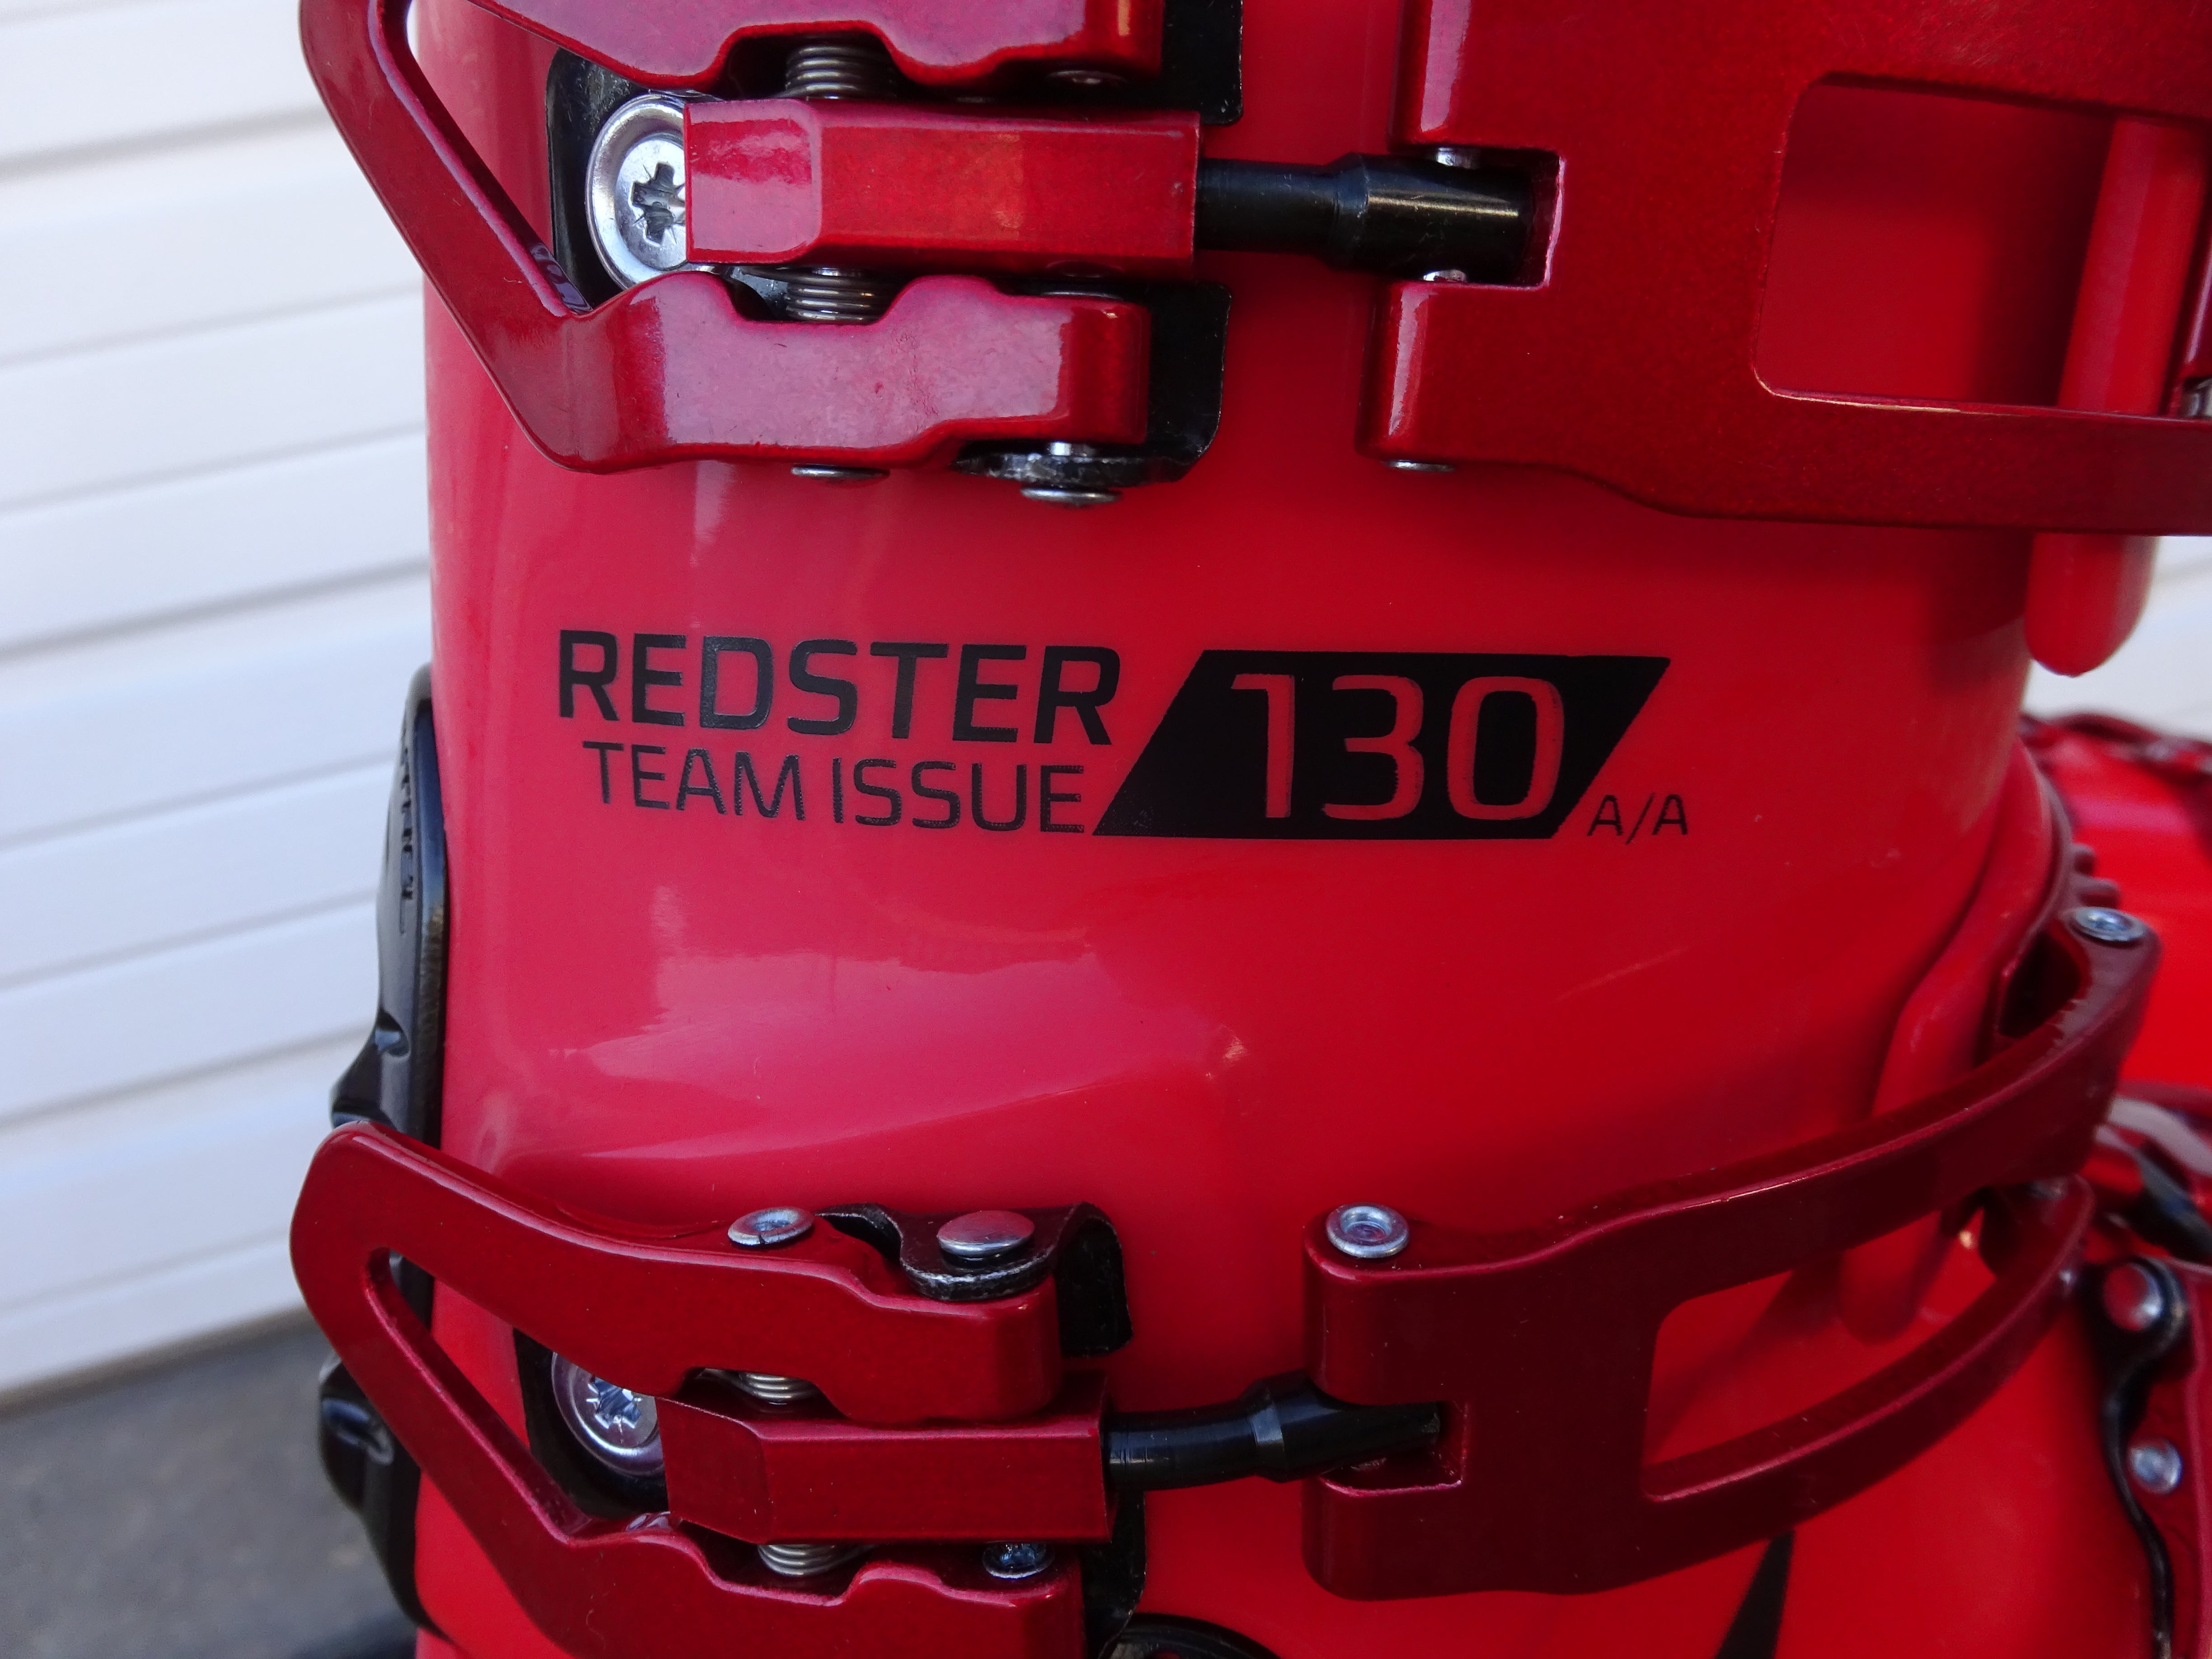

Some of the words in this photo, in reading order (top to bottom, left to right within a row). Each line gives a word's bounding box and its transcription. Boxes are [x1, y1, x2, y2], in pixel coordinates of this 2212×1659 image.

[558, 628, 1121, 746] REDSTER
[582, 740, 806, 820] TEAM
[832, 756, 1085, 834] ISSUE
[1231, 672, 1565, 821] 130
[1586, 793, 1689, 845] A/A
